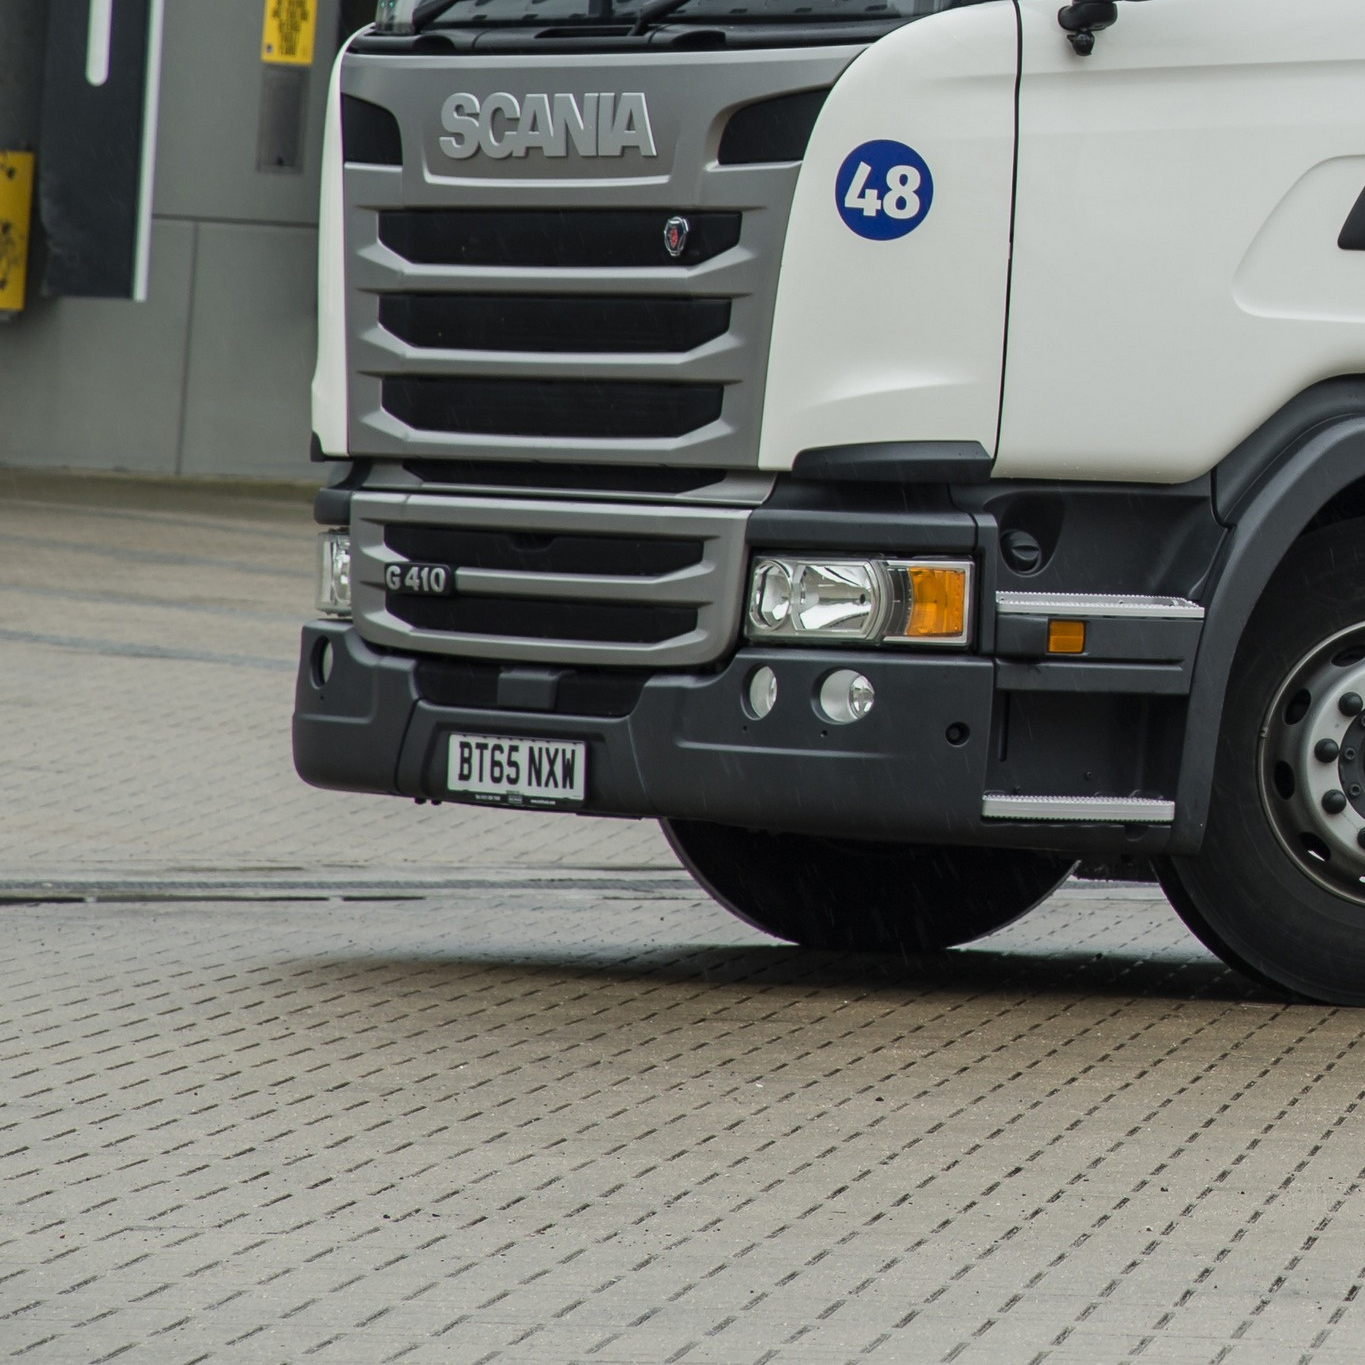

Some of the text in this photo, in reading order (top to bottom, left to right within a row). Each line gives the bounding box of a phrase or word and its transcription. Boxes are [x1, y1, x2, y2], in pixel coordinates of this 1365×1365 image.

[439, 92, 657, 159] SCANIA
[845, 161, 921, 219] 48
[386, 565, 446, 593] G 410
[458, 741, 576, 790] BT65 NXW
